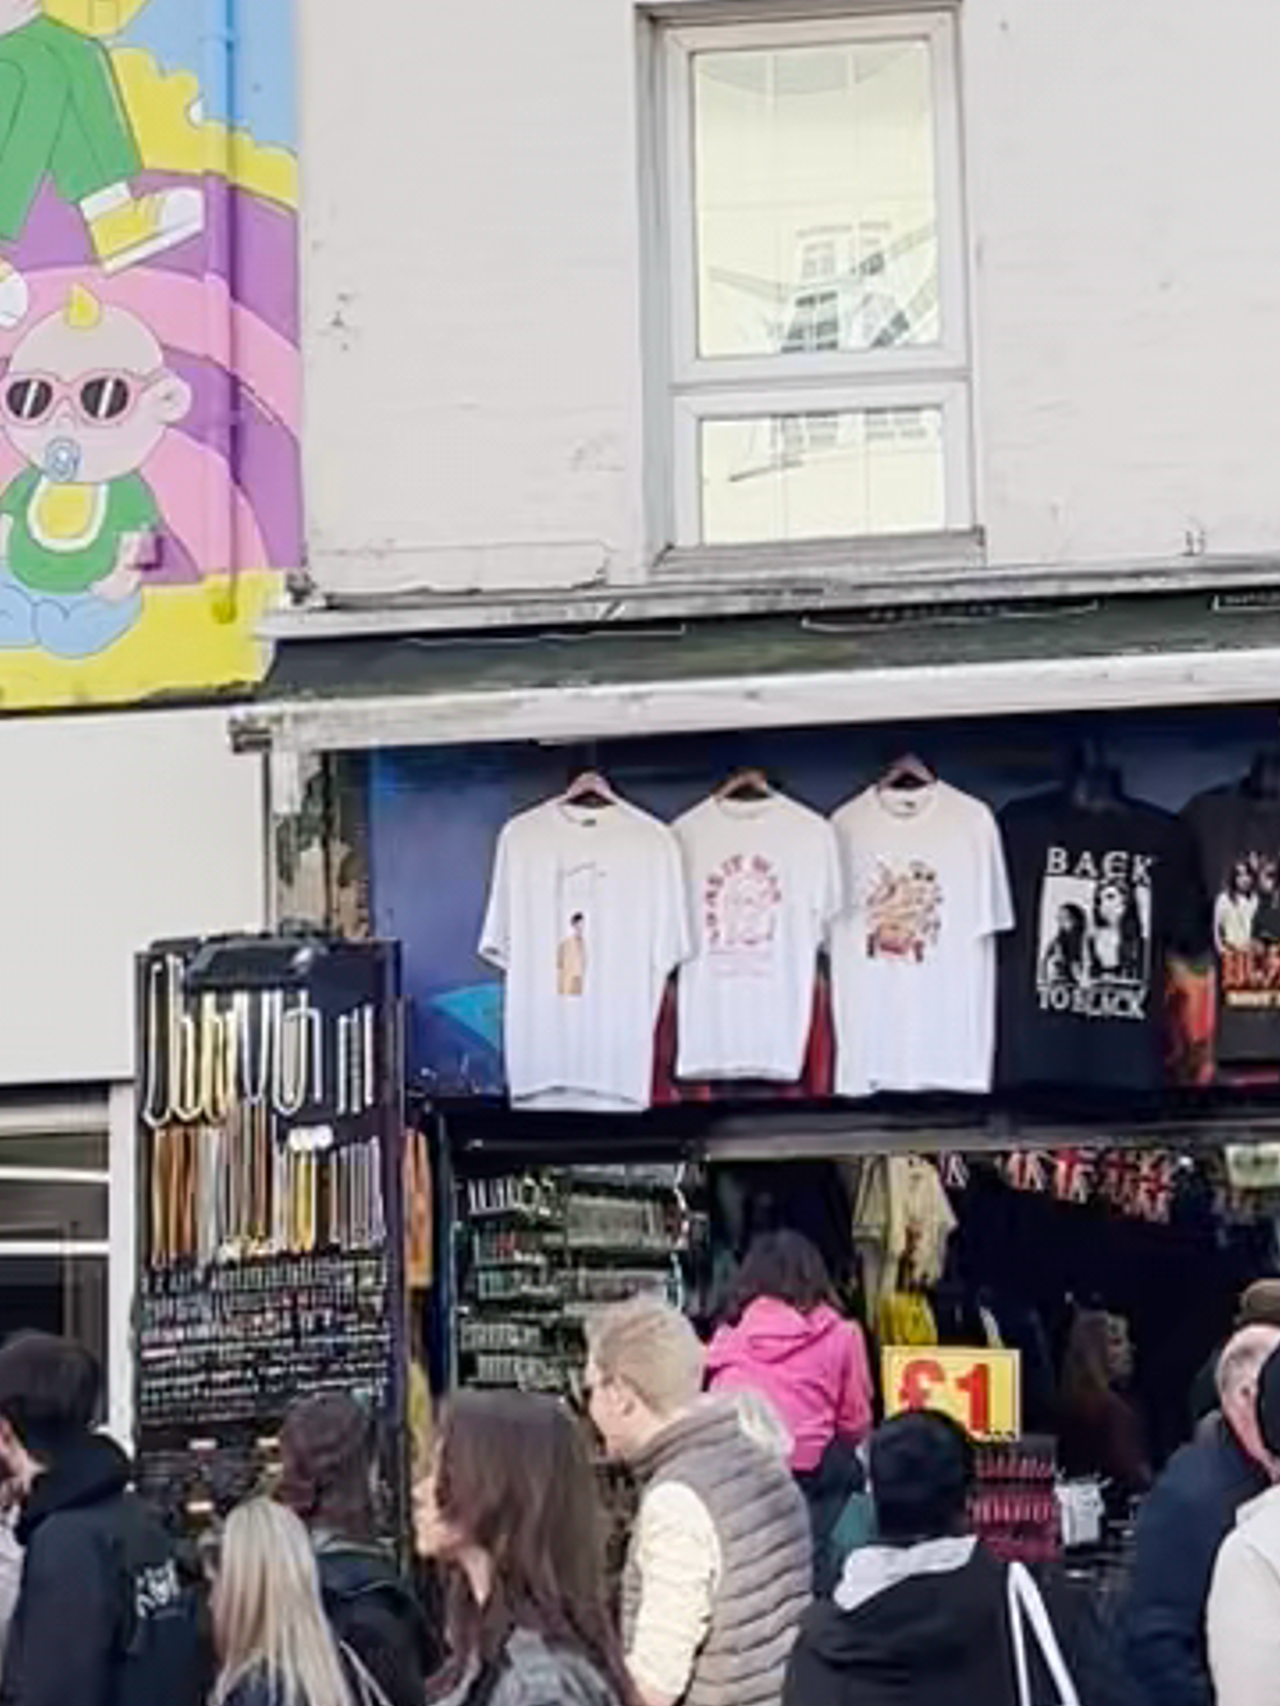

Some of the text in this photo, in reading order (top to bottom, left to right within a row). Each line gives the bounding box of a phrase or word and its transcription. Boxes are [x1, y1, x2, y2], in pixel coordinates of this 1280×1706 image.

[1046, 847, 1152, 885] BACK
[1037, 987, 1149, 1020] TO BLACK
[898, 1360, 989, 1434] £1
